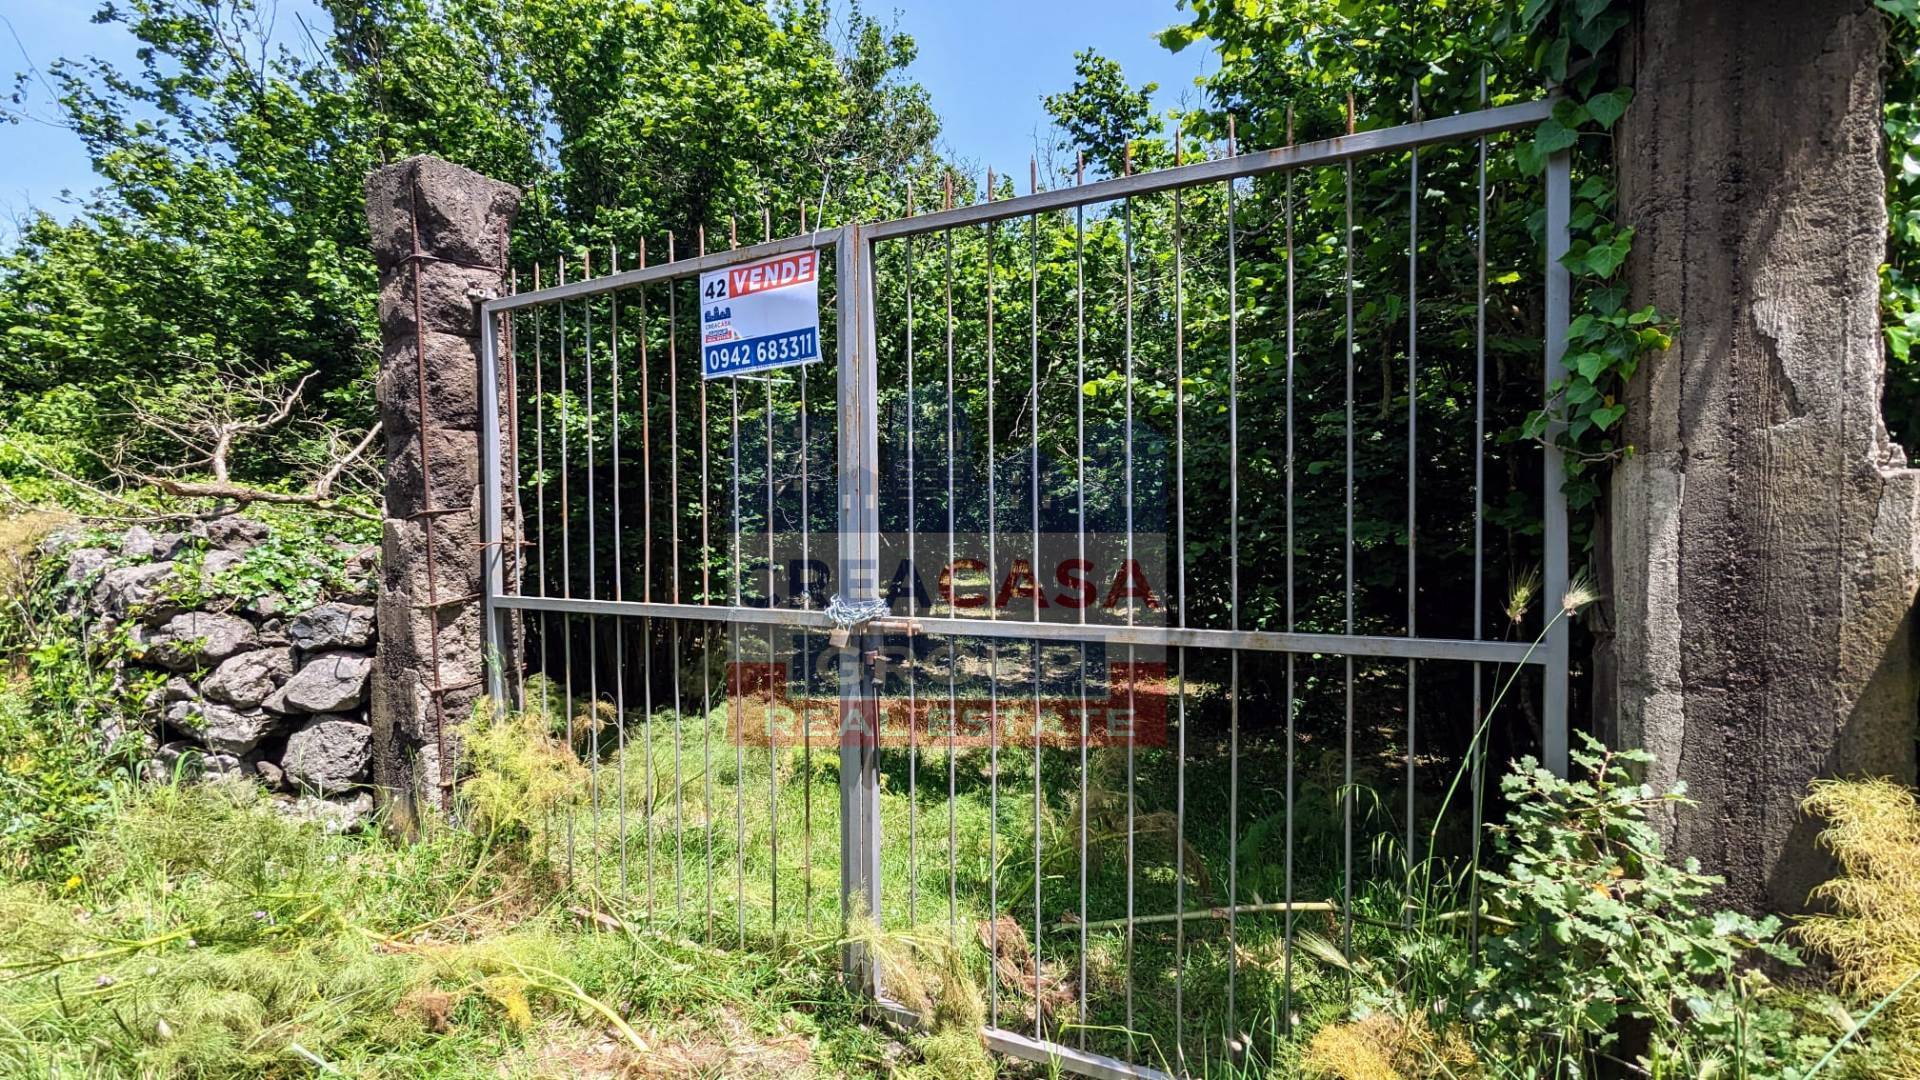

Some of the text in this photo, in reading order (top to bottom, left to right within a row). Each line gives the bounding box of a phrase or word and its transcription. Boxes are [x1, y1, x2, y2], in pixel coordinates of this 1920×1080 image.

[705, 256, 811, 299] 42 VENDE
[709, 344, 751, 370] 0942
[756, 333, 812, 362] 683311
